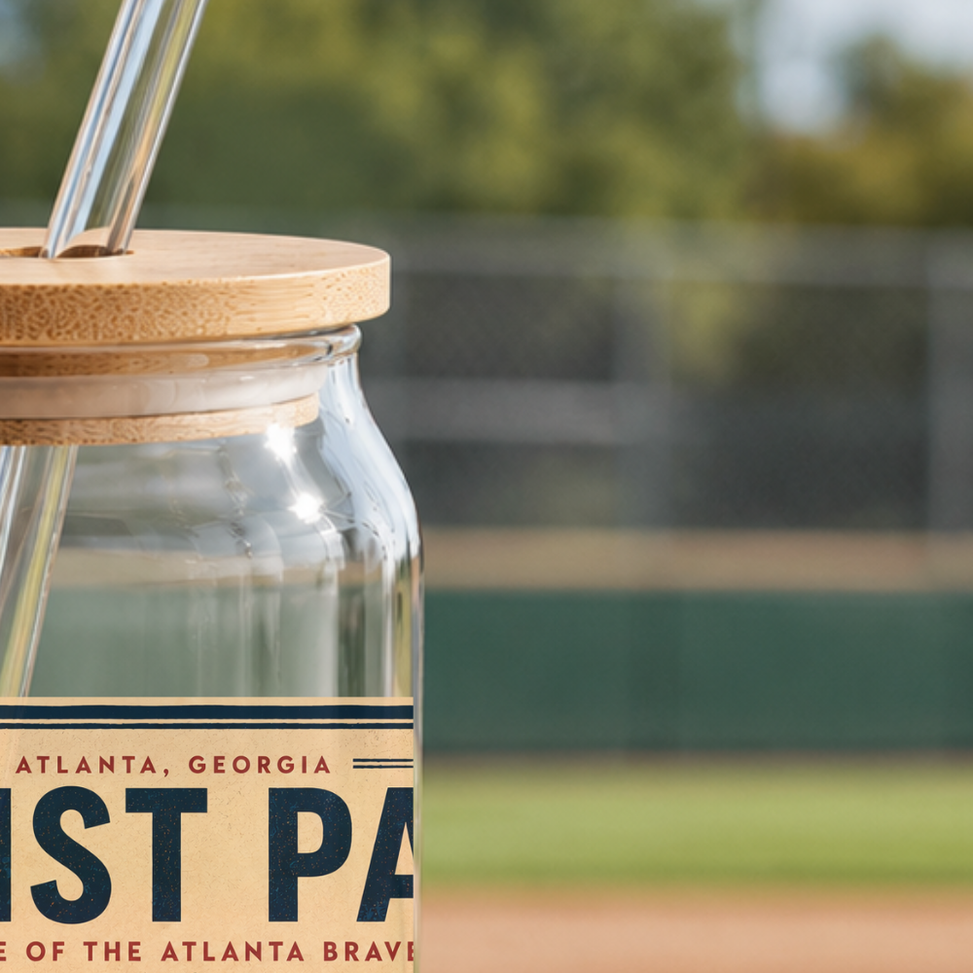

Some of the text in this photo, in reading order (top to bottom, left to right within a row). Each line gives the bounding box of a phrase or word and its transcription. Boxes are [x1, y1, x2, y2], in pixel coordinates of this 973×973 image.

[15, 755, 331, 778] ATLANTA, GEORGIA
[26, 941, 65, 962] OF
[83, 941, 142, 962] THE
[161, 941, 305, 962] ATLANTA
